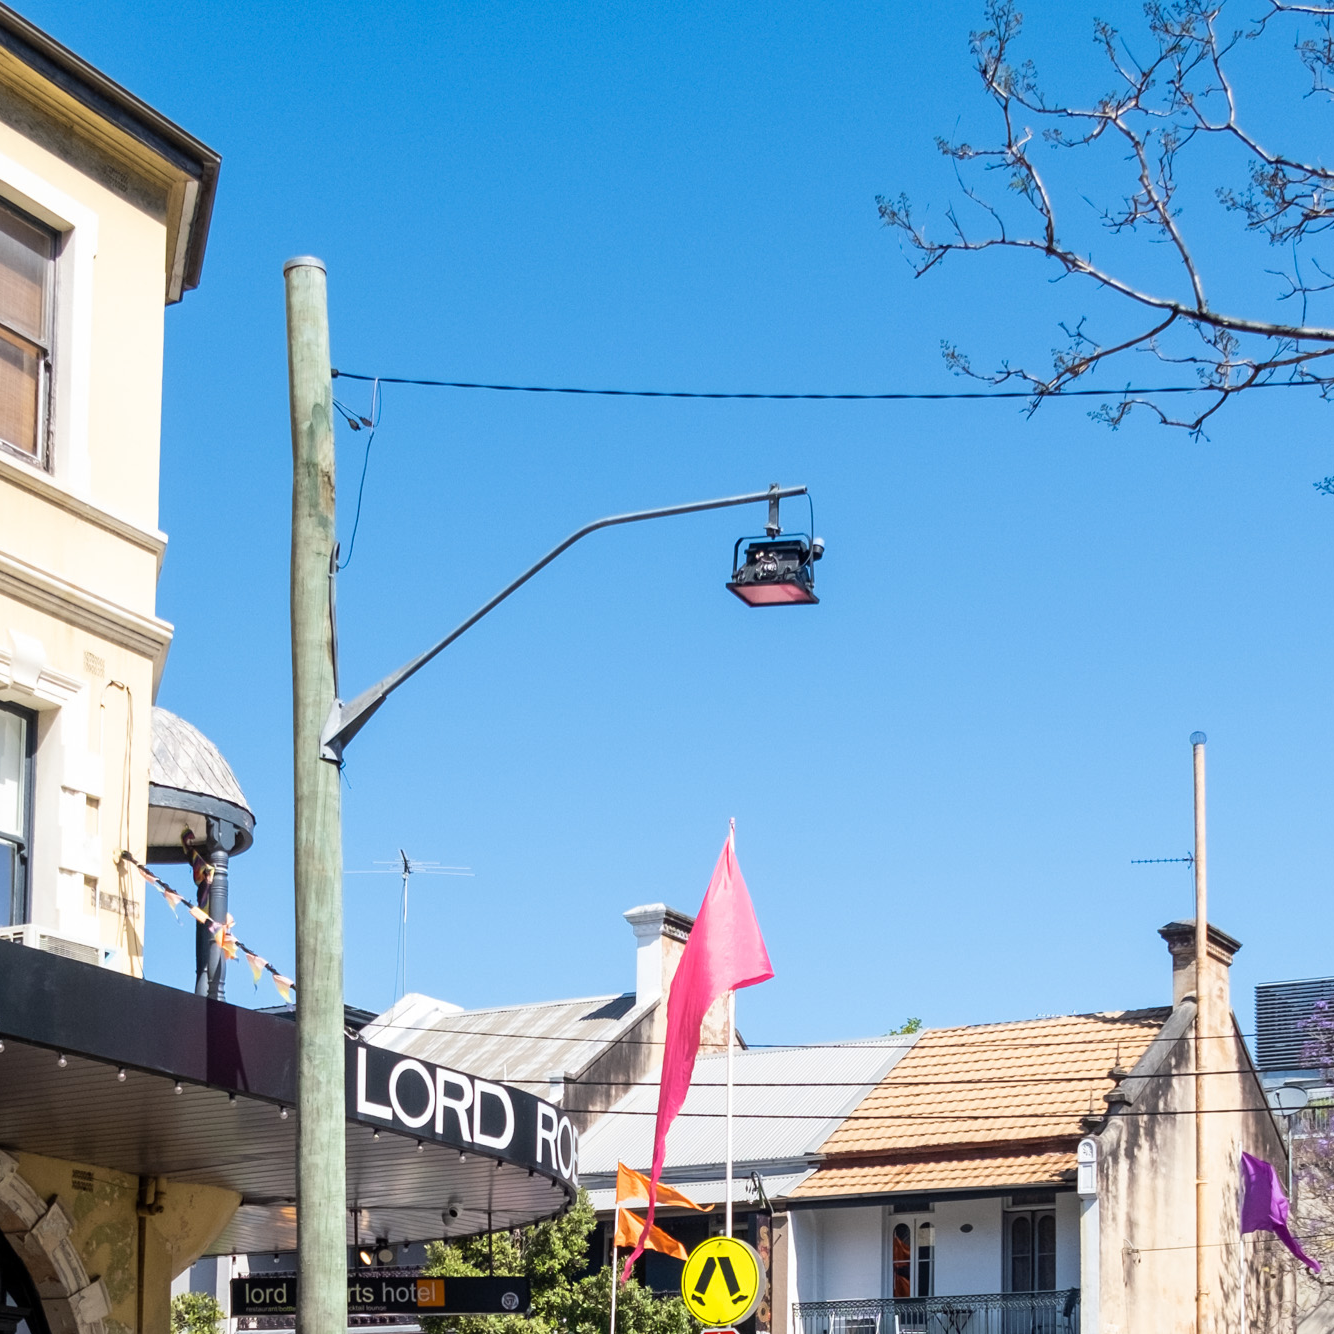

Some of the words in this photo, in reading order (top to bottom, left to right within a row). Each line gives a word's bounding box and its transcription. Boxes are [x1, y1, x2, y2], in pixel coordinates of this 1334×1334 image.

[356, 1046, 515, 1150] LORD
[245, 1283, 287, 1304] lord
[382, 1281, 437, 1303] hotel
